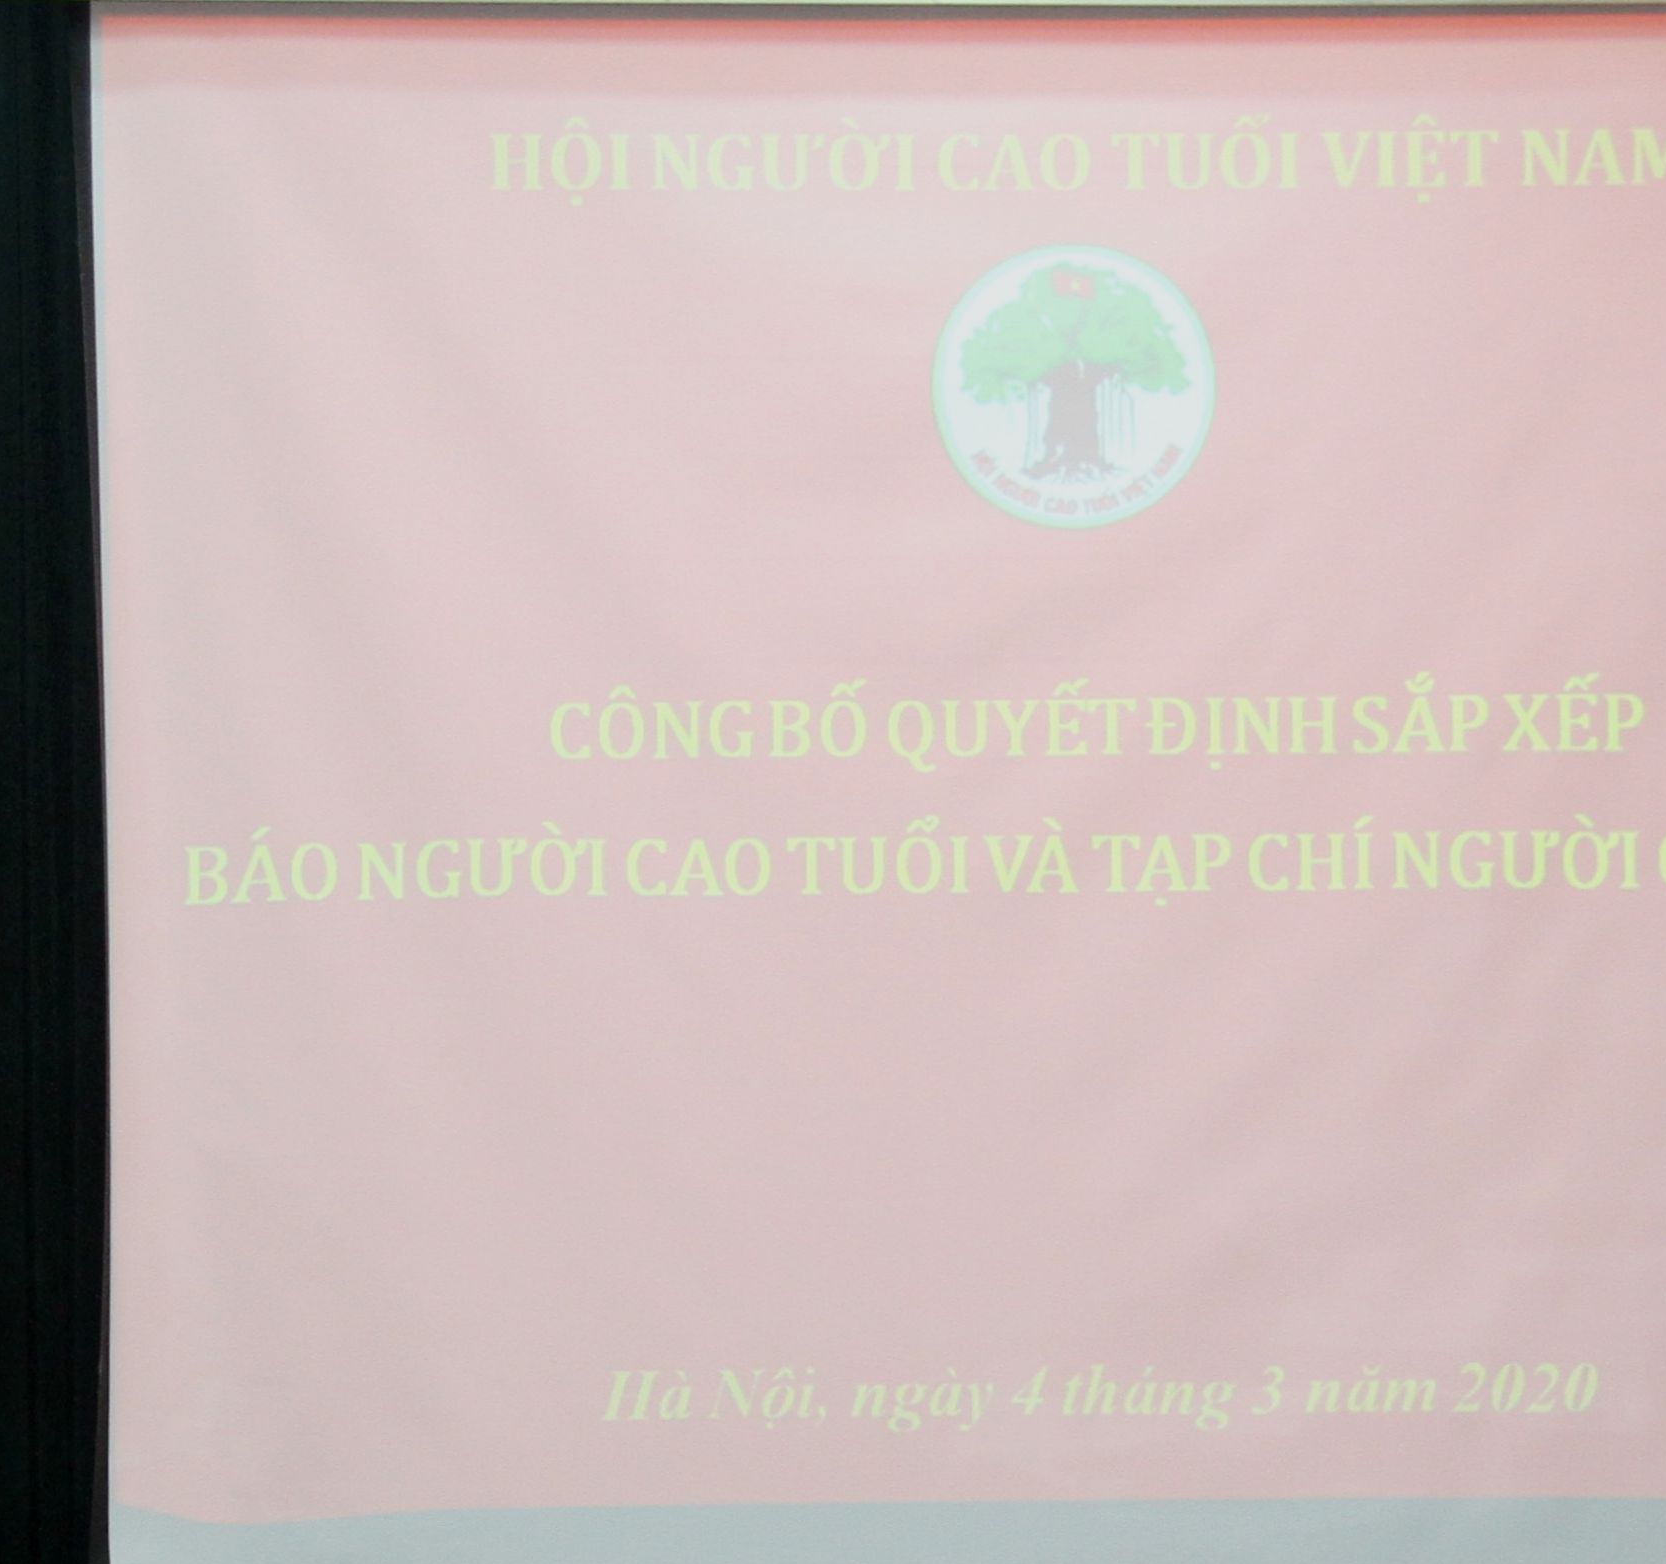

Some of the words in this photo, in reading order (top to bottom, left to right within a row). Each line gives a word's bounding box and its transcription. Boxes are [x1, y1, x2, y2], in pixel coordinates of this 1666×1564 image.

[491, 115, 632, 207] HỘI
[652, 116, 916, 193] NGƯỜI
[935, 131, 1093, 193] CAO
[1109, 112, 1301, 192] TUỔI
[1322, 111, 1503, 206] VIỆT
[547, 681, 758, 764] CÔNG
[767, 675, 871, 762] BỐ
[884, 674, 1140, 775] QUYẾT
[1144, 692, 1341, 772] ĐỊNH
[1348, 668, 1493, 757] SẮP
[1500, 669, 1650, 756] XẾP
[182, 822, 341, 908] BÁO
[356, 818, 610, 905] NGƯỜI
[623, 834, 776, 899] CAO
[783, 813, 972, 898] TUỔI
[981, 814, 1082, 897] VÀ
[1088, 830, 1236, 910] TẠP
[1244, 812, 1376, 895] CHÍ
[1390, 809, 1642, 894] NGƯỜI
[603, 1367, 694, 1423] Hà
[850, 1366, 997, 1437] ngày
[1011, 1364, 1050, 1418] 4
[1059, 1362, 1238, 1432] tháng
[1251, 1363, 1288, 1418] 3
[1303, 1363, 1438, 1417] năm
[1453, 1360, 1602, 1417] 2020
